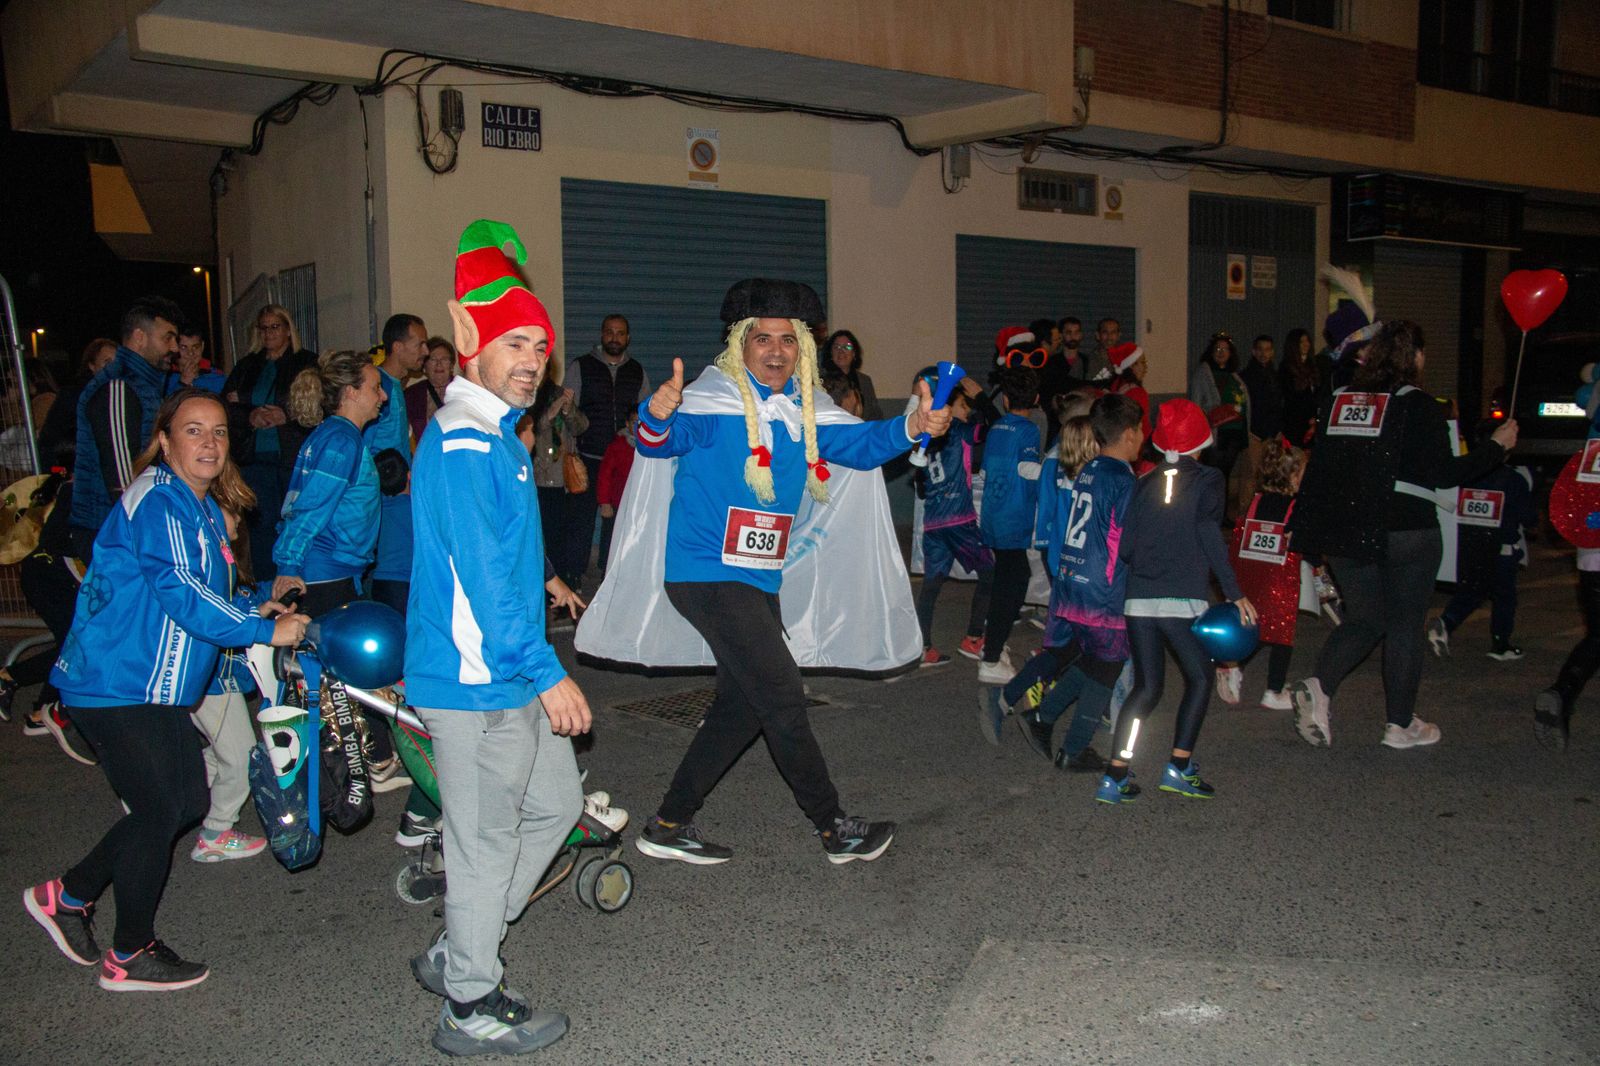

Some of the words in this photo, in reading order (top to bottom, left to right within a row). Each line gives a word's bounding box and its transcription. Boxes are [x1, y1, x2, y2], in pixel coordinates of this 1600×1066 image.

[485, 105, 538, 128] CALLE
[484, 127, 504, 147] RIO
[508, 129, 540, 150] EBRO
[1343, 406, 1370, 422] 283
[1467, 501, 1489, 514] 660
[1065, 489, 1092, 550] 12
[745, 530, 776, 552] 638
[1253, 534, 1276, 549] 285
[167, 653, 177, 668] DE
[330, 680, 352, 726] BIMBA
[342, 731, 364, 776] BIMBA
